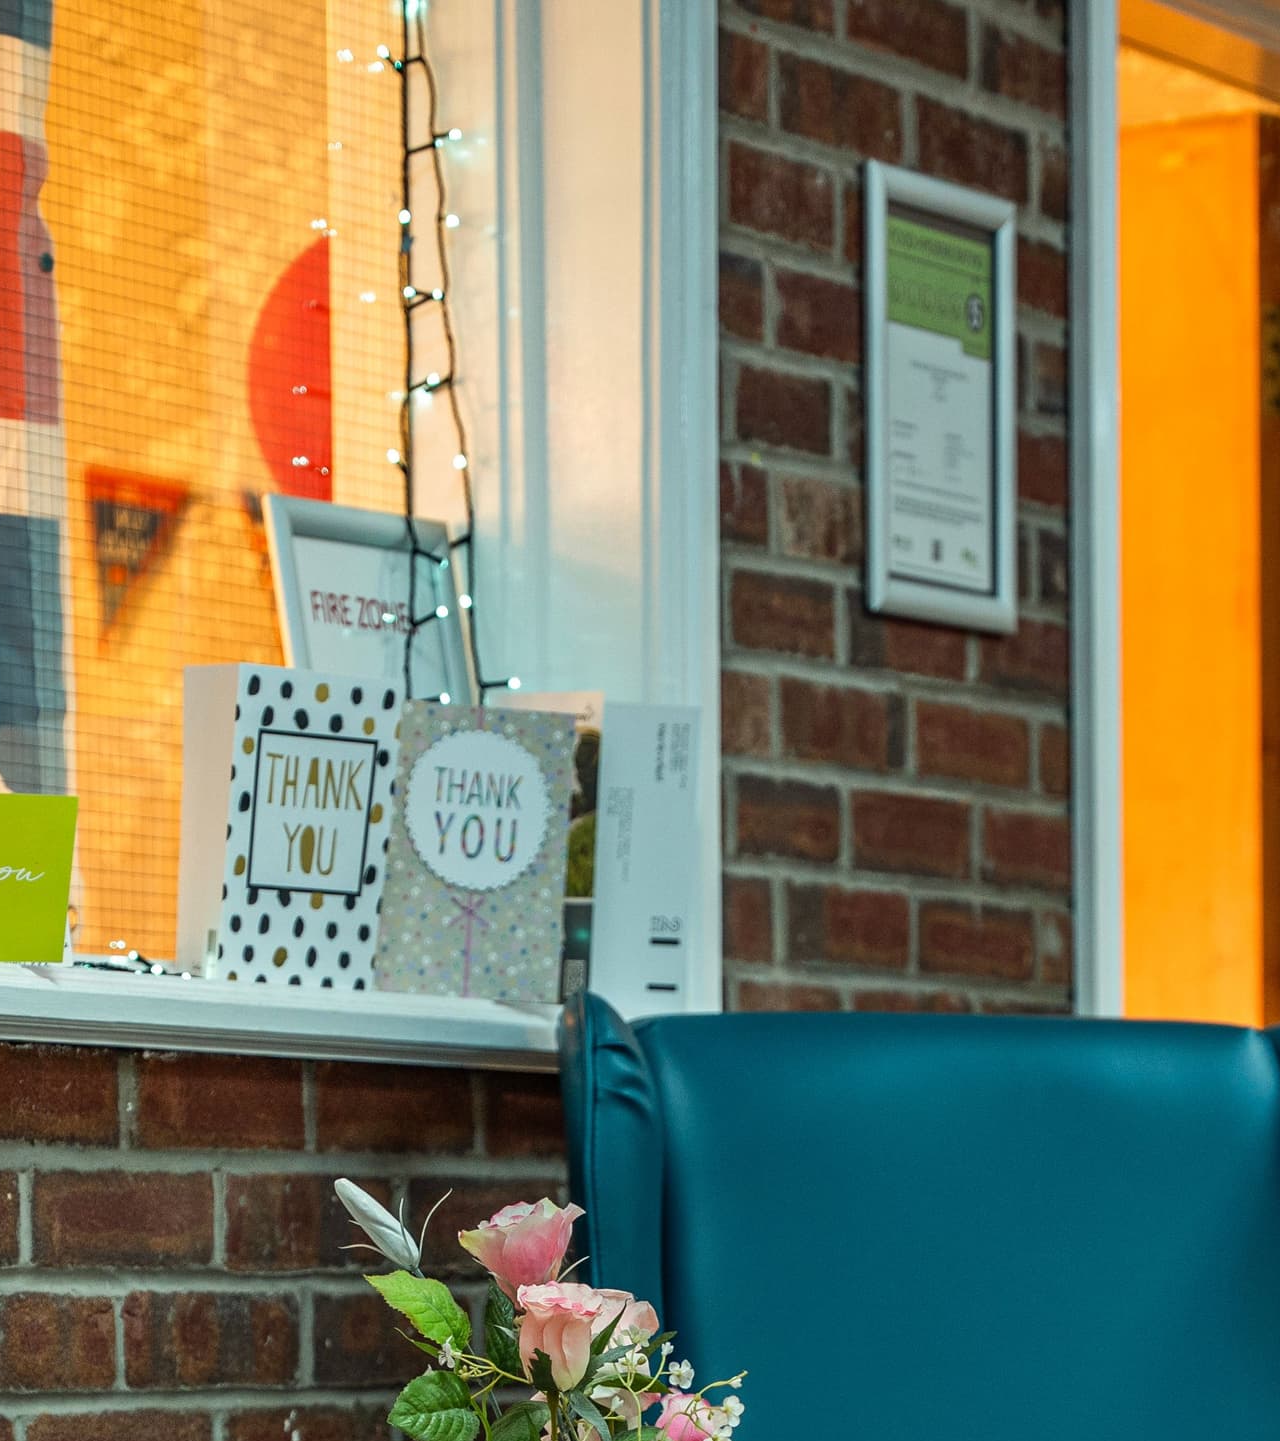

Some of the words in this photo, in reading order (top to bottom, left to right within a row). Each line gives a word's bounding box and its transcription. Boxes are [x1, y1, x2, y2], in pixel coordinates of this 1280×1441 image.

[310, 590, 353, 626] FIRE
[266, 751, 365, 811] THANK
[434, 765, 524, 811] THANK
[283, 821, 338, 876] YOU
[434, 810, 518, 863] YOU
